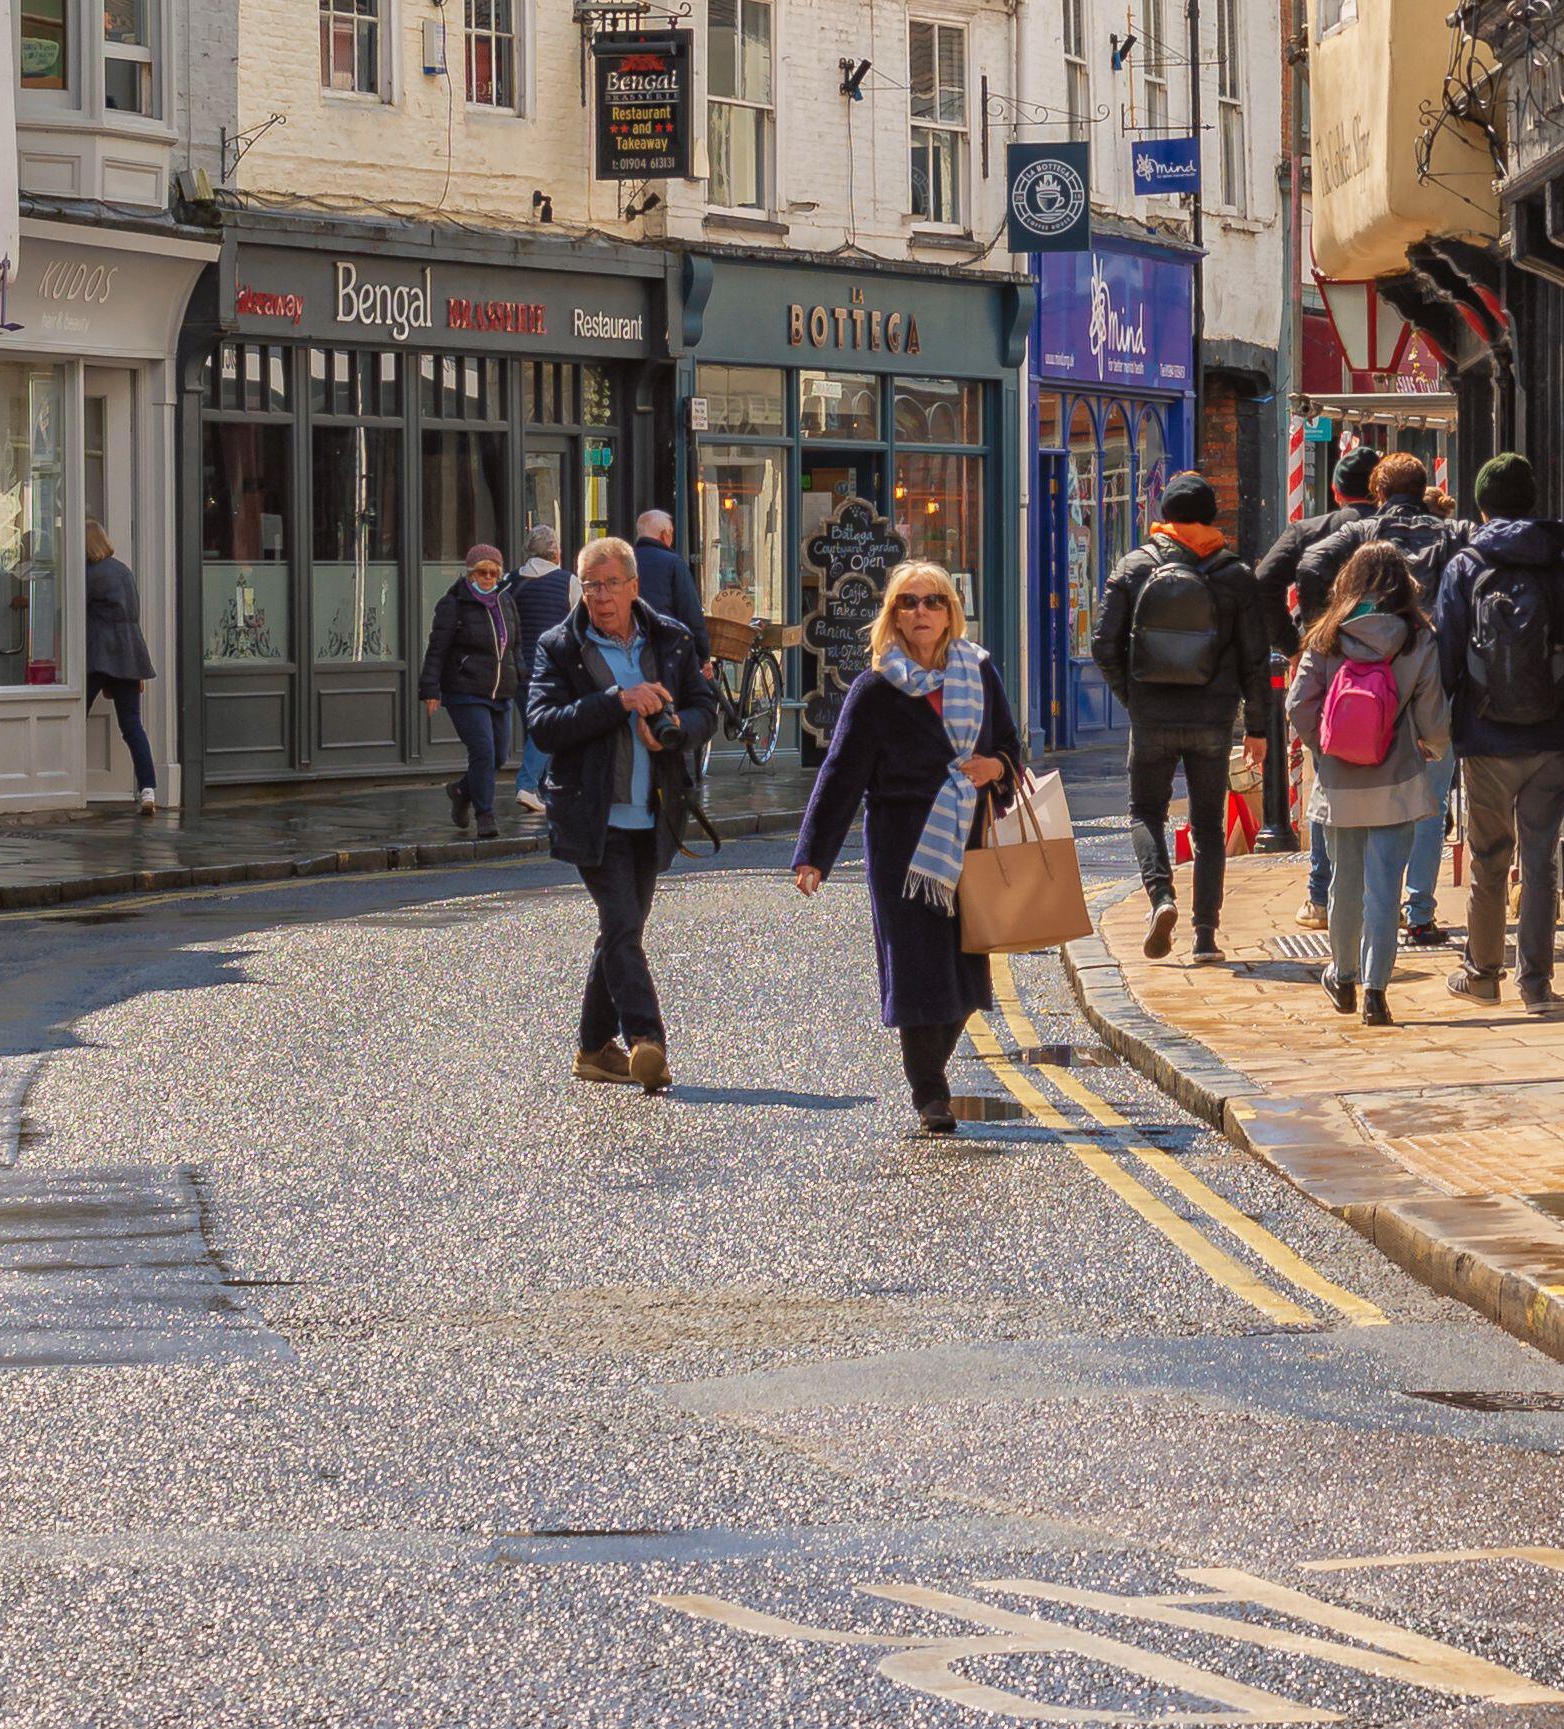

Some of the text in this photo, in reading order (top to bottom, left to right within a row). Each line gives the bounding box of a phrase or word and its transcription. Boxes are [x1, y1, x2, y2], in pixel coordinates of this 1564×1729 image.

[606, 70, 680, 96] Bengal
[612, 106, 671, 121] Restaurant
[633, 122, 652, 134] and
[616, 136, 668, 152] Takeaway
[1036, 163, 1071, 177] BOTTEGA
[38, 260, 119, 304] KUDOS
[335, 260, 433, 341] Bengal
[446, 296, 547, 335] BRASSERIE
[573, 307, 643, 343] Restaurant
[851, 287, 865, 305] LA
[789, 303, 921, 355] BOTTEGA
[850, 554, 887, 575] Open
[715, 590, 752, 608] COFFEE
[829, 601, 858, 618] Take
